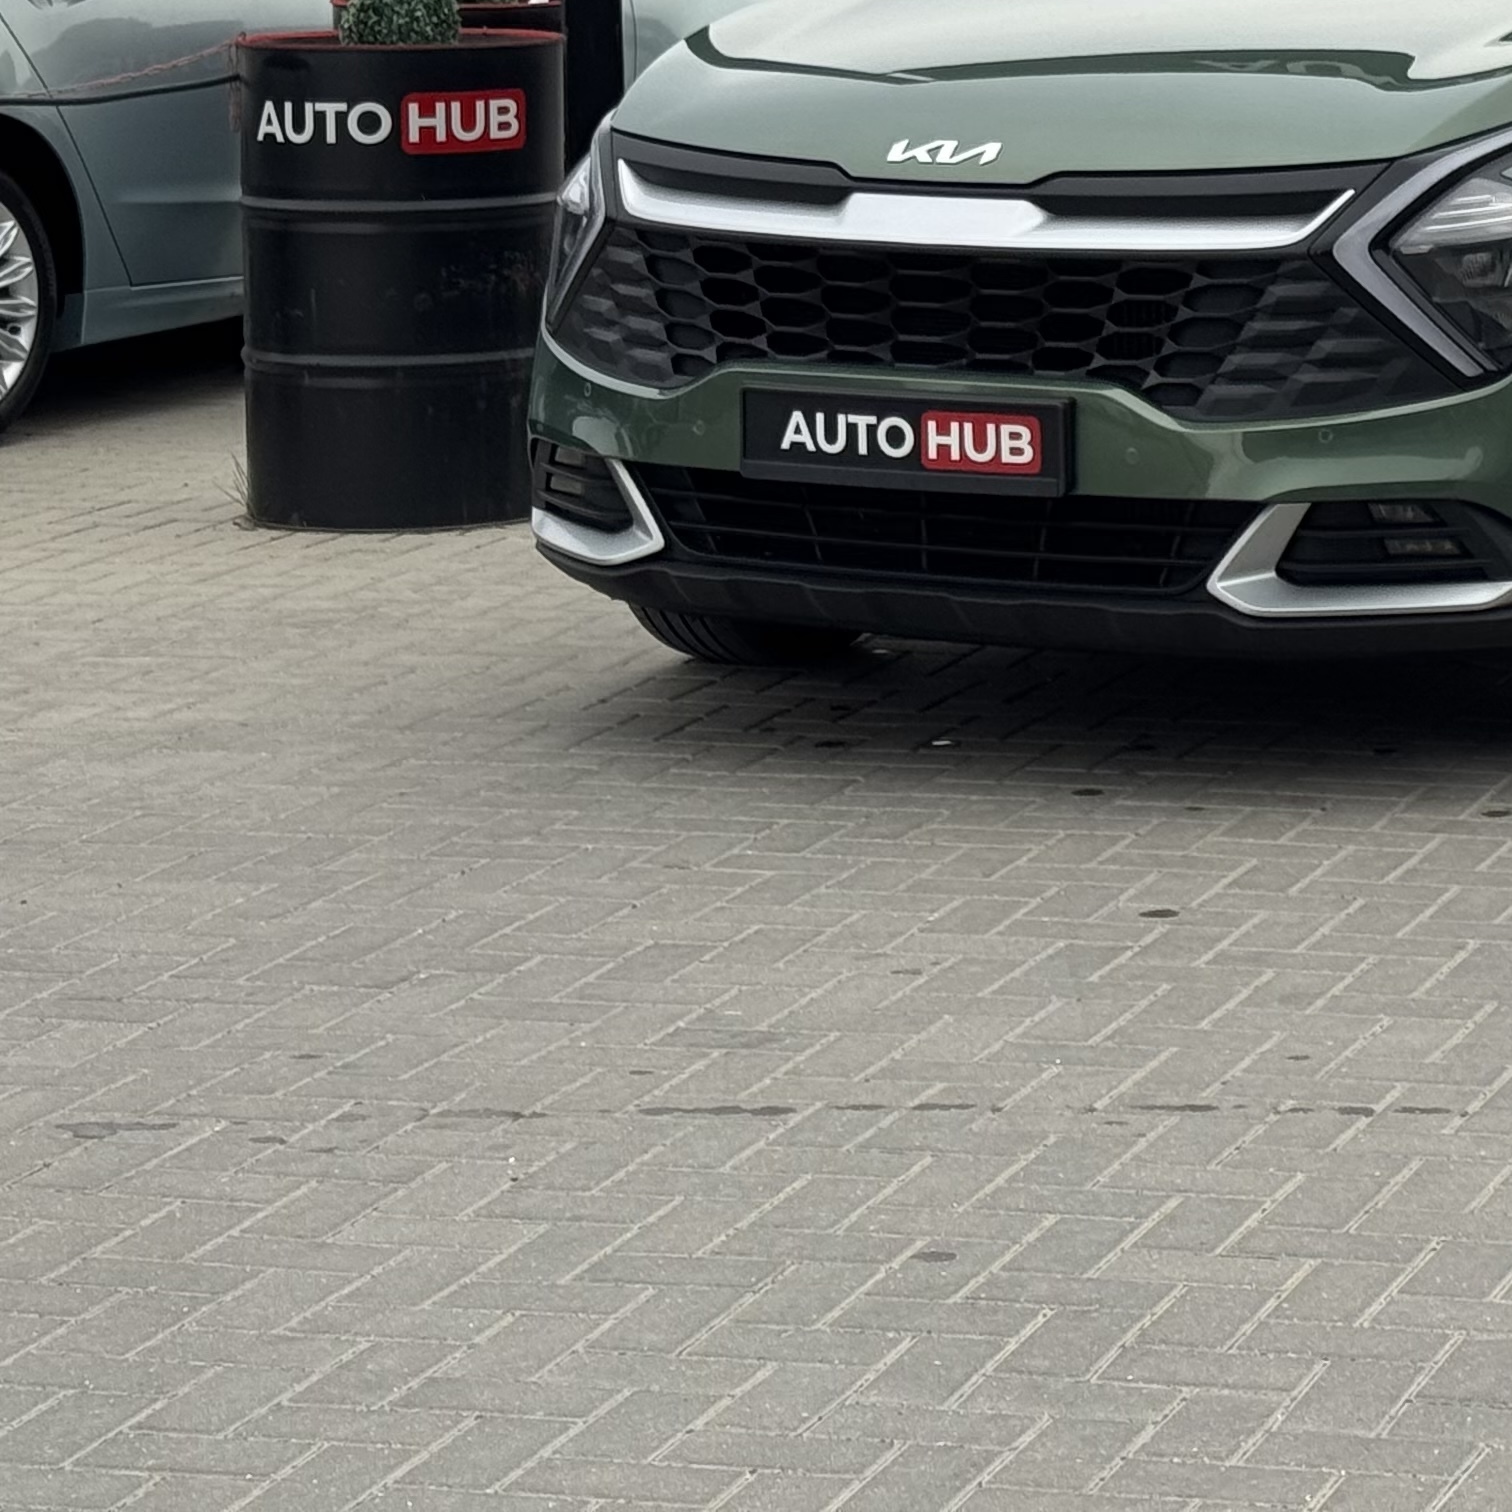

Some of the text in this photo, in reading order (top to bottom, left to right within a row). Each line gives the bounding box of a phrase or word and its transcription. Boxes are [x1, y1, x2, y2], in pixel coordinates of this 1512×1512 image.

[256, 98, 519, 145] AUTO HUB
[886, 138, 1002, 165] KIA
[780, 410, 1034, 464] AUTO HUB
